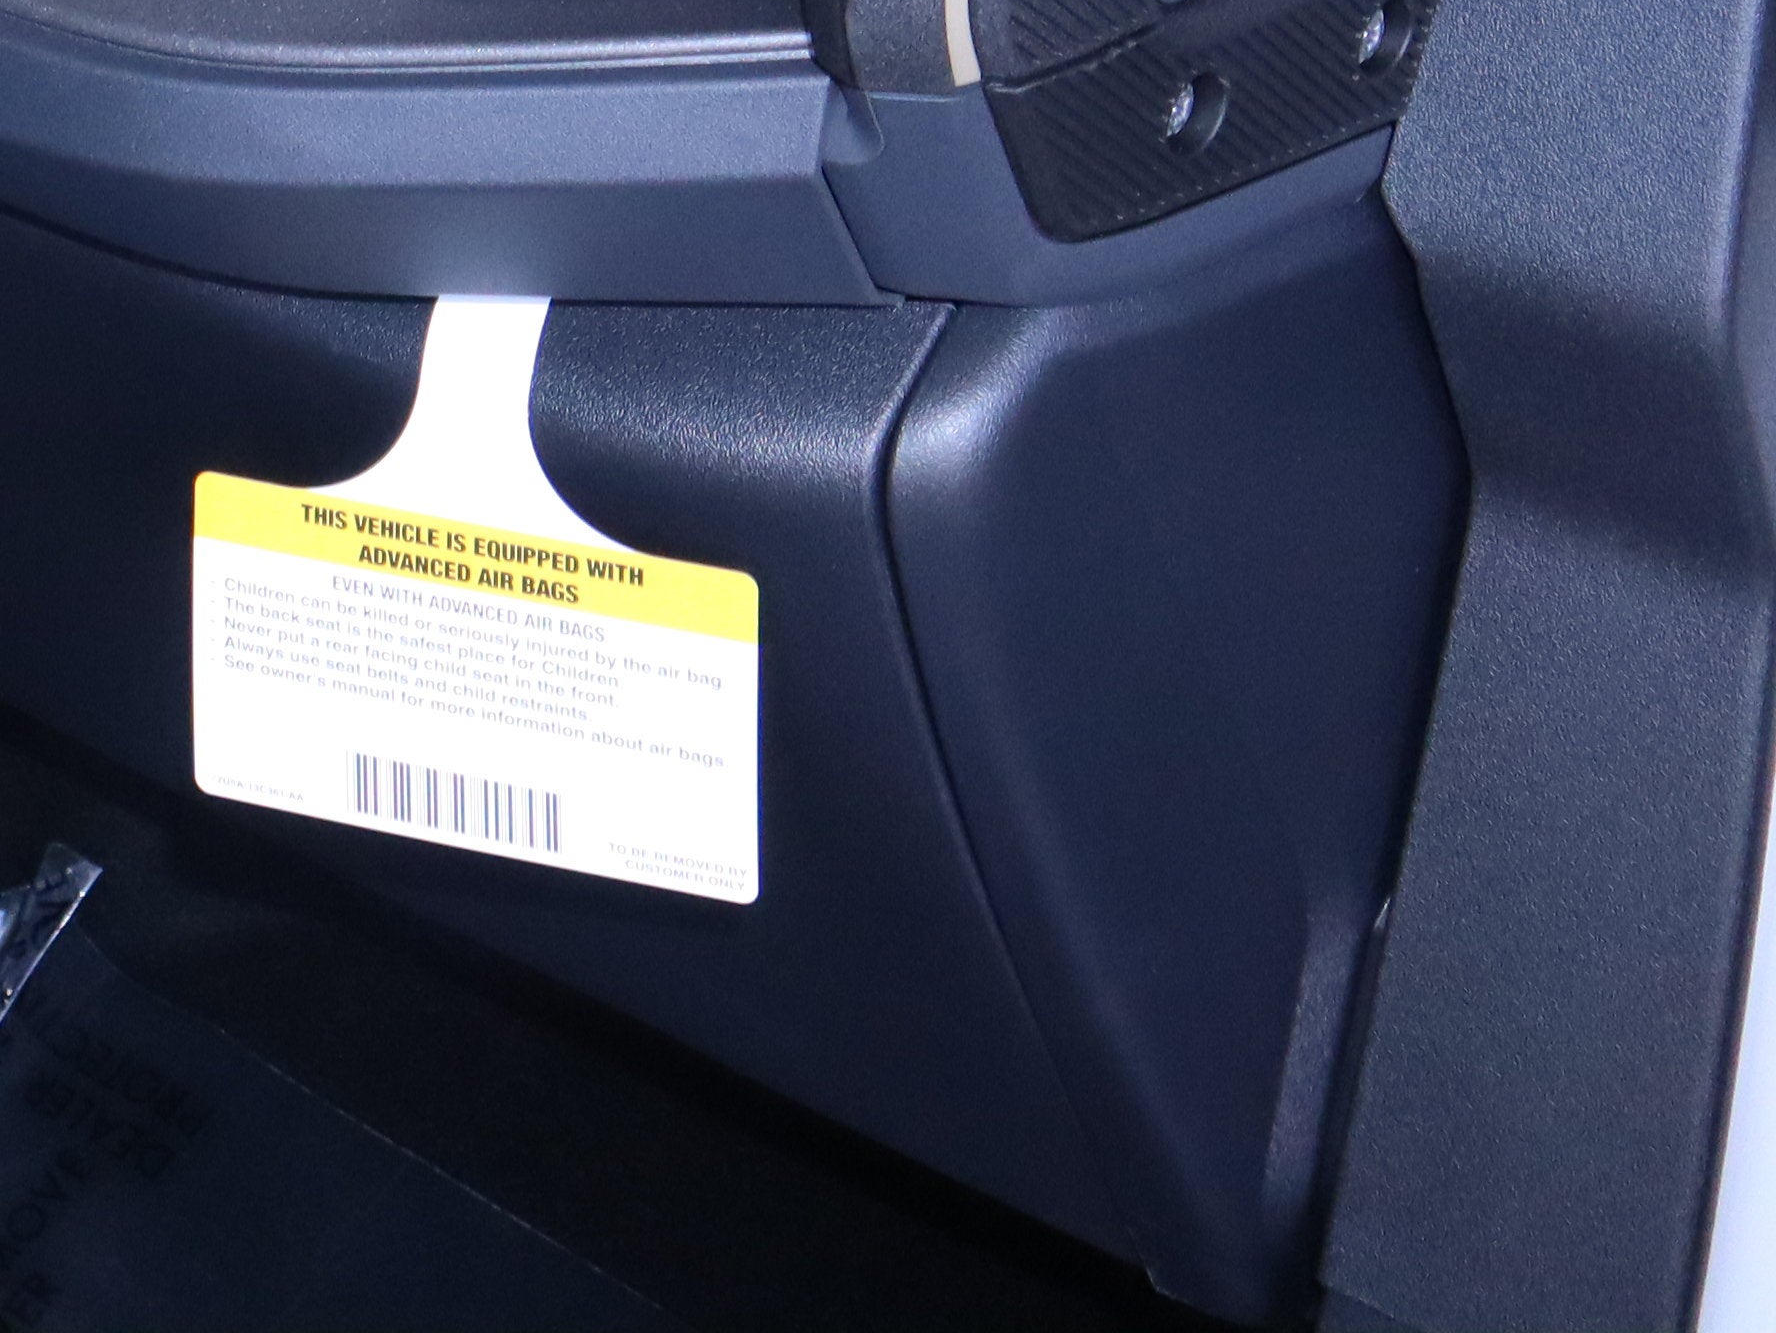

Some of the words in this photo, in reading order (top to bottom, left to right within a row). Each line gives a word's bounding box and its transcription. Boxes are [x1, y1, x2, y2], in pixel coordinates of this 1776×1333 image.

[301, 503, 347, 530] THIS
[354, 514, 439, 548] VEHICLE
[447, 532, 466, 553] IS
[474, 537, 579, 574] EQUIPPED
[587, 558, 643, 587] WITH
[359, 544, 471, 583] ADVANCED
[478, 568, 513, 592] AIR
[522, 576, 579, 604] BAGS
[224, 596, 254, 614] The
[261, 604, 299, 623] back
[306, 616, 340, 633] seat
[348, 621, 360, 636] is
[367, 626, 393, 643] the
[400, 636, 451, 654] safest
[459, 646, 504, 664] place
[512, 654, 535, 670] for
[225, 577, 294, 603] Children
[301, 596, 330, 612] can
[337, 599, 357, 616] be
[362, 605, 408, 626] killed
[415, 619, 432, 631] or
[439, 624, 519, 651] seriously
[527, 638, 588, 661] injured
[596, 651, 616, 670] by
[624, 657, 651, 673] the
[658, 666, 680, 679] air
[333, 575, 373, 597] EVEN
[380, 585, 422, 606] WITH
[429, 595, 517, 625] ADVANCED
[524, 613, 552, 631] AIR
[560, 620, 604, 642] BAGS
[224, 636, 284, 661] Always
[291, 652, 320, 667] use
[326, 659, 360, 675] seat
[368, 664, 408, 685] belts
[415, 677, 446, 692] and
[453, 684, 495, 702] child
[225, 615, 272, 637] Never
[278, 630, 304, 644] put
[311, 637, 319, 647] a
[326, 640, 358, 655] rear
[366, 645, 417, 670] facing
[424, 658, 466, 677] child
[473, 669, 508, 686] seat
[516, 675, 531, 690] in
[538, 680, 565, 696] the
[225, 654, 254, 672] See
[332, 679, 394, 701] manual
[402, 691, 424, 706] for
[431, 700, 475, 717] more
[482, 708, 584, 740] information
[592, 732, 642, 751] about
[650, 743, 672, 756] air
